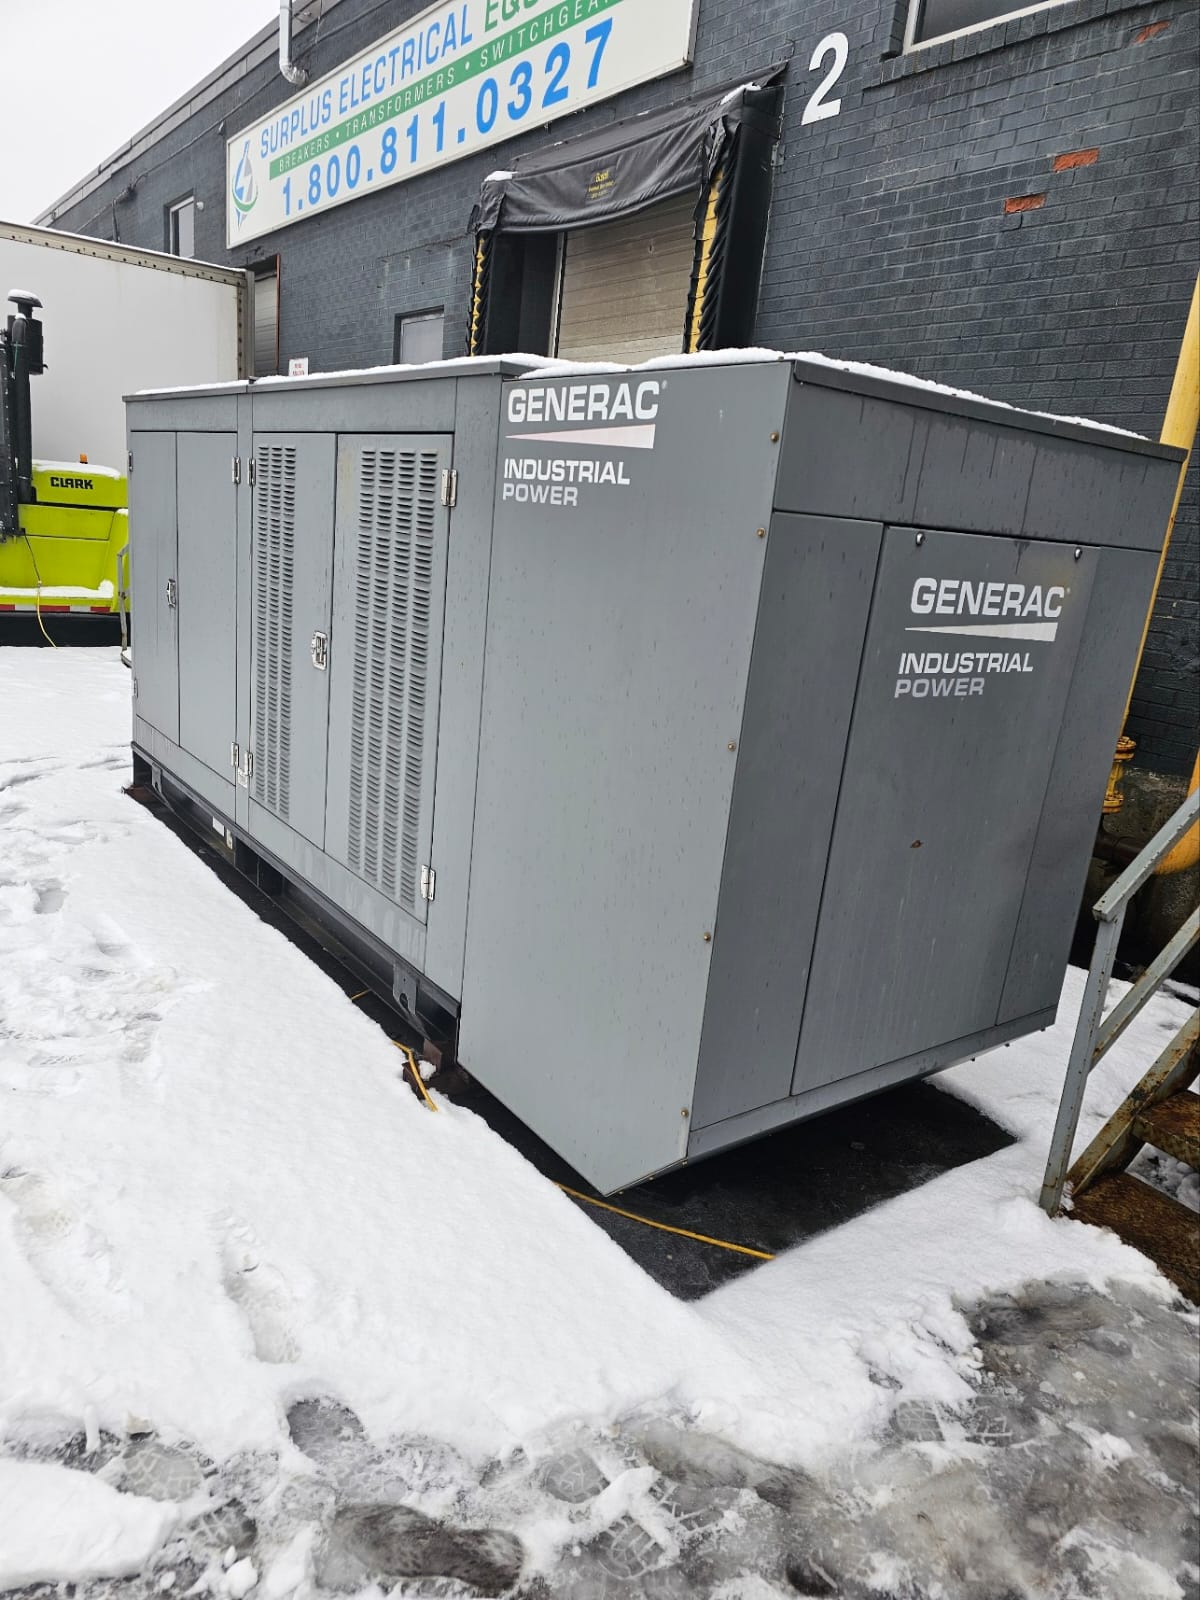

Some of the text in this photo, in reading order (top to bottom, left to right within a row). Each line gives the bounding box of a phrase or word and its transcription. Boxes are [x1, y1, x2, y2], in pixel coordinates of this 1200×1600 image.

[260, 0, 538, 159] SURPLUS ELECTRICAL EQ
[279, 0, 607, 172] BREAKERS TRANSFORMERS SWITCHGEA
[801, 32, 849, 126] 2
[283, 17, 613, 216] 1.800.811.0327
[508, 381, 660, 423] GENERAC
[50, 476, 94, 490] CLARK
[504, 458, 631, 485] INDUSTRIAL
[502, 483, 578, 507] POWER
[910, 577, 1065, 618] GENERAC
[898, 653, 1034, 675] INDUSTRIAL
[894, 677, 985, 698] POWER
